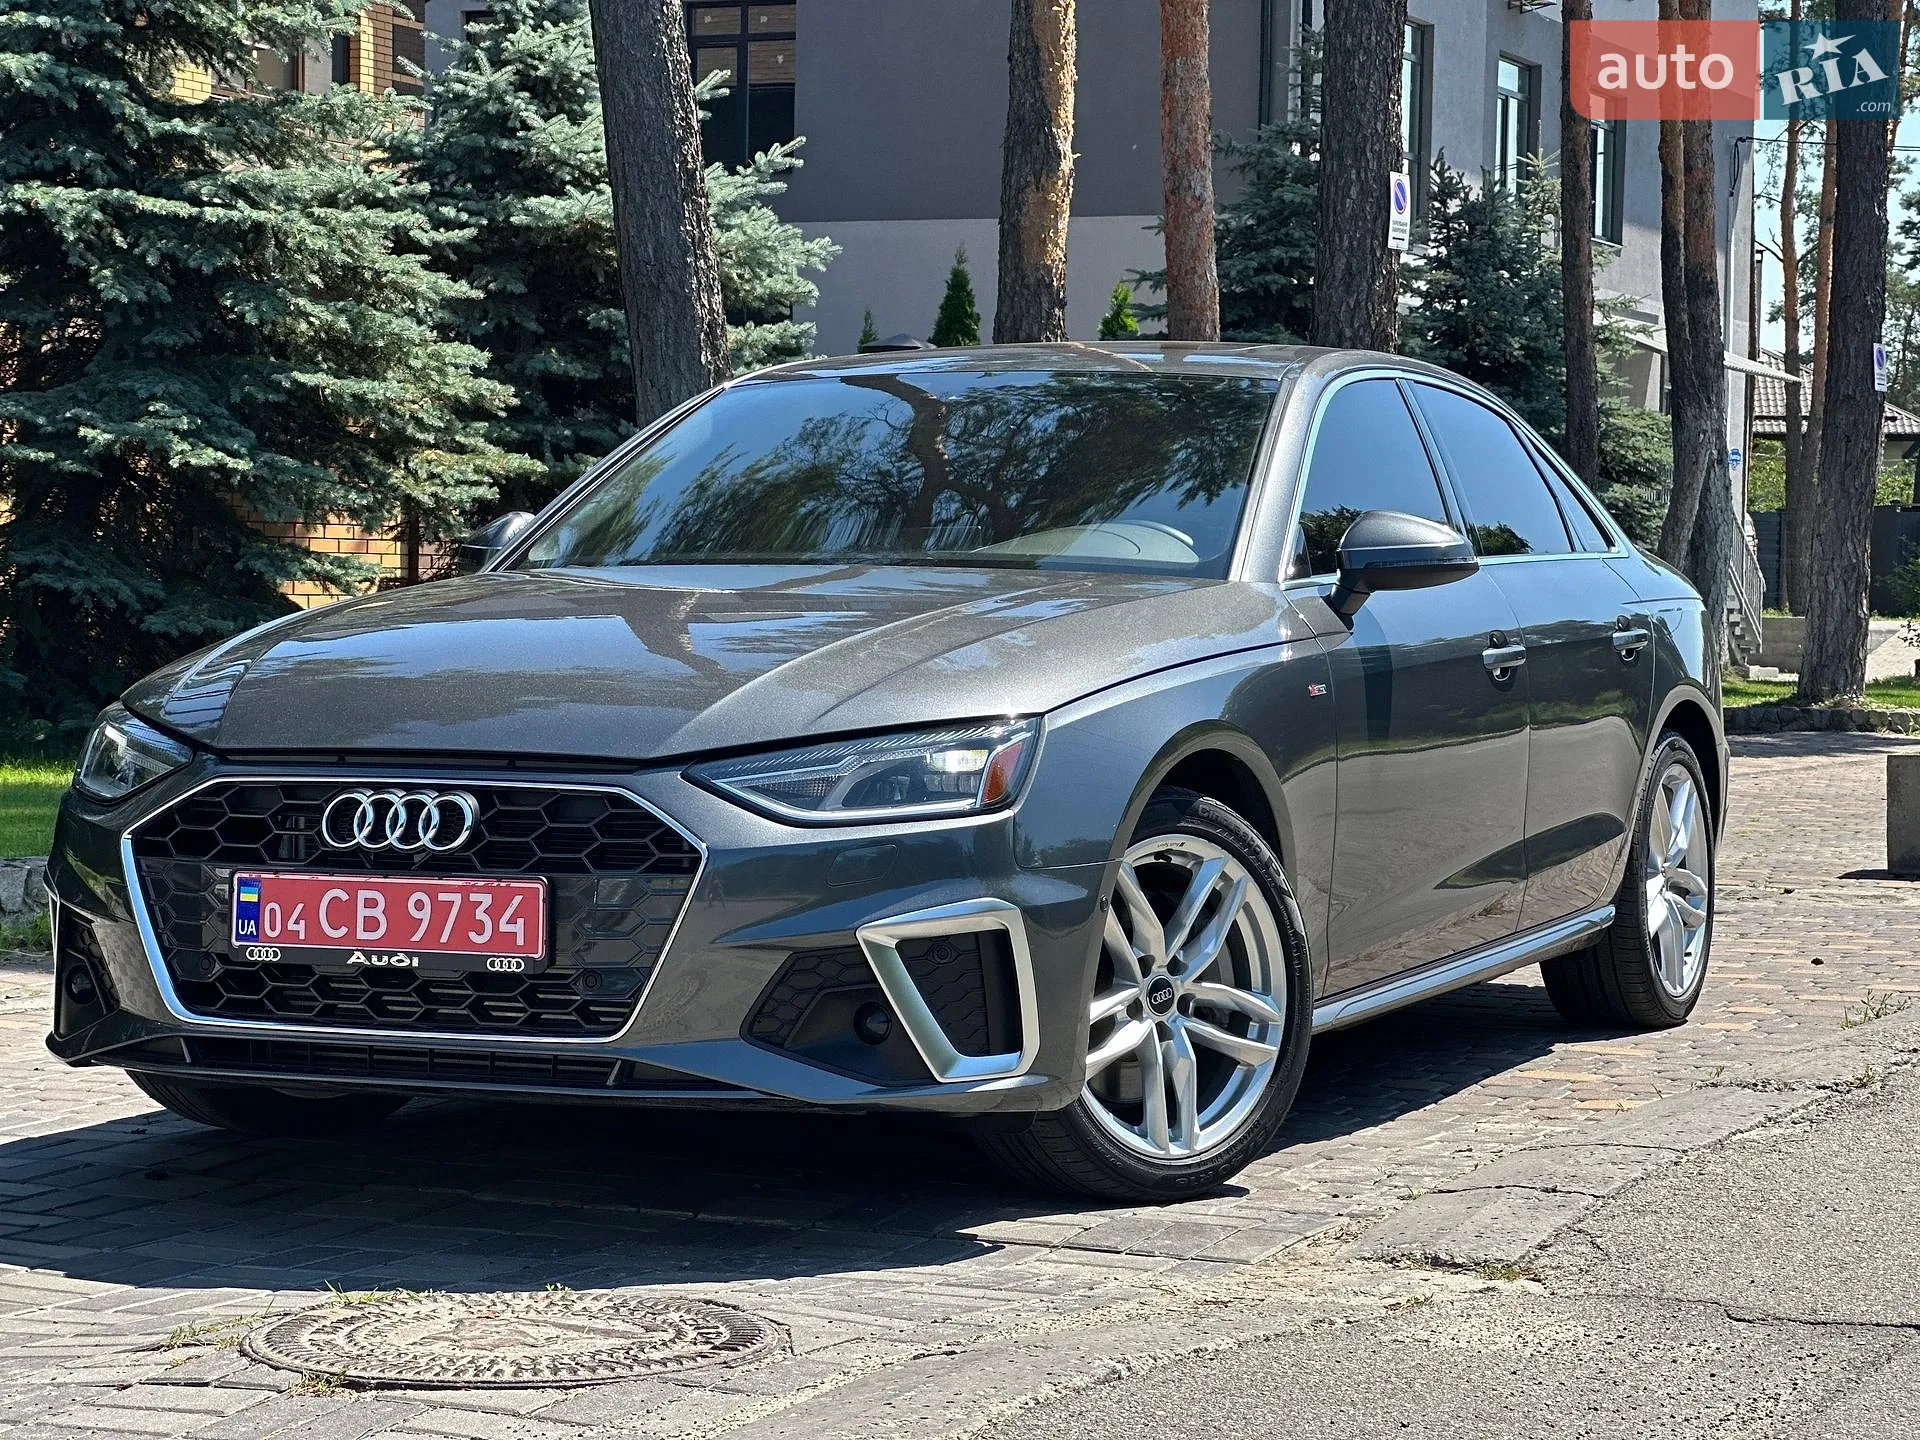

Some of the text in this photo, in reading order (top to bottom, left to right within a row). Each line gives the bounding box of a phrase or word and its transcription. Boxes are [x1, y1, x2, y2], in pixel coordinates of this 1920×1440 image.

[264, 888, 525, 946] 04 CB 9734
[238, 919, 257, 936] UA
[346, 950, 419, 967] Audi
